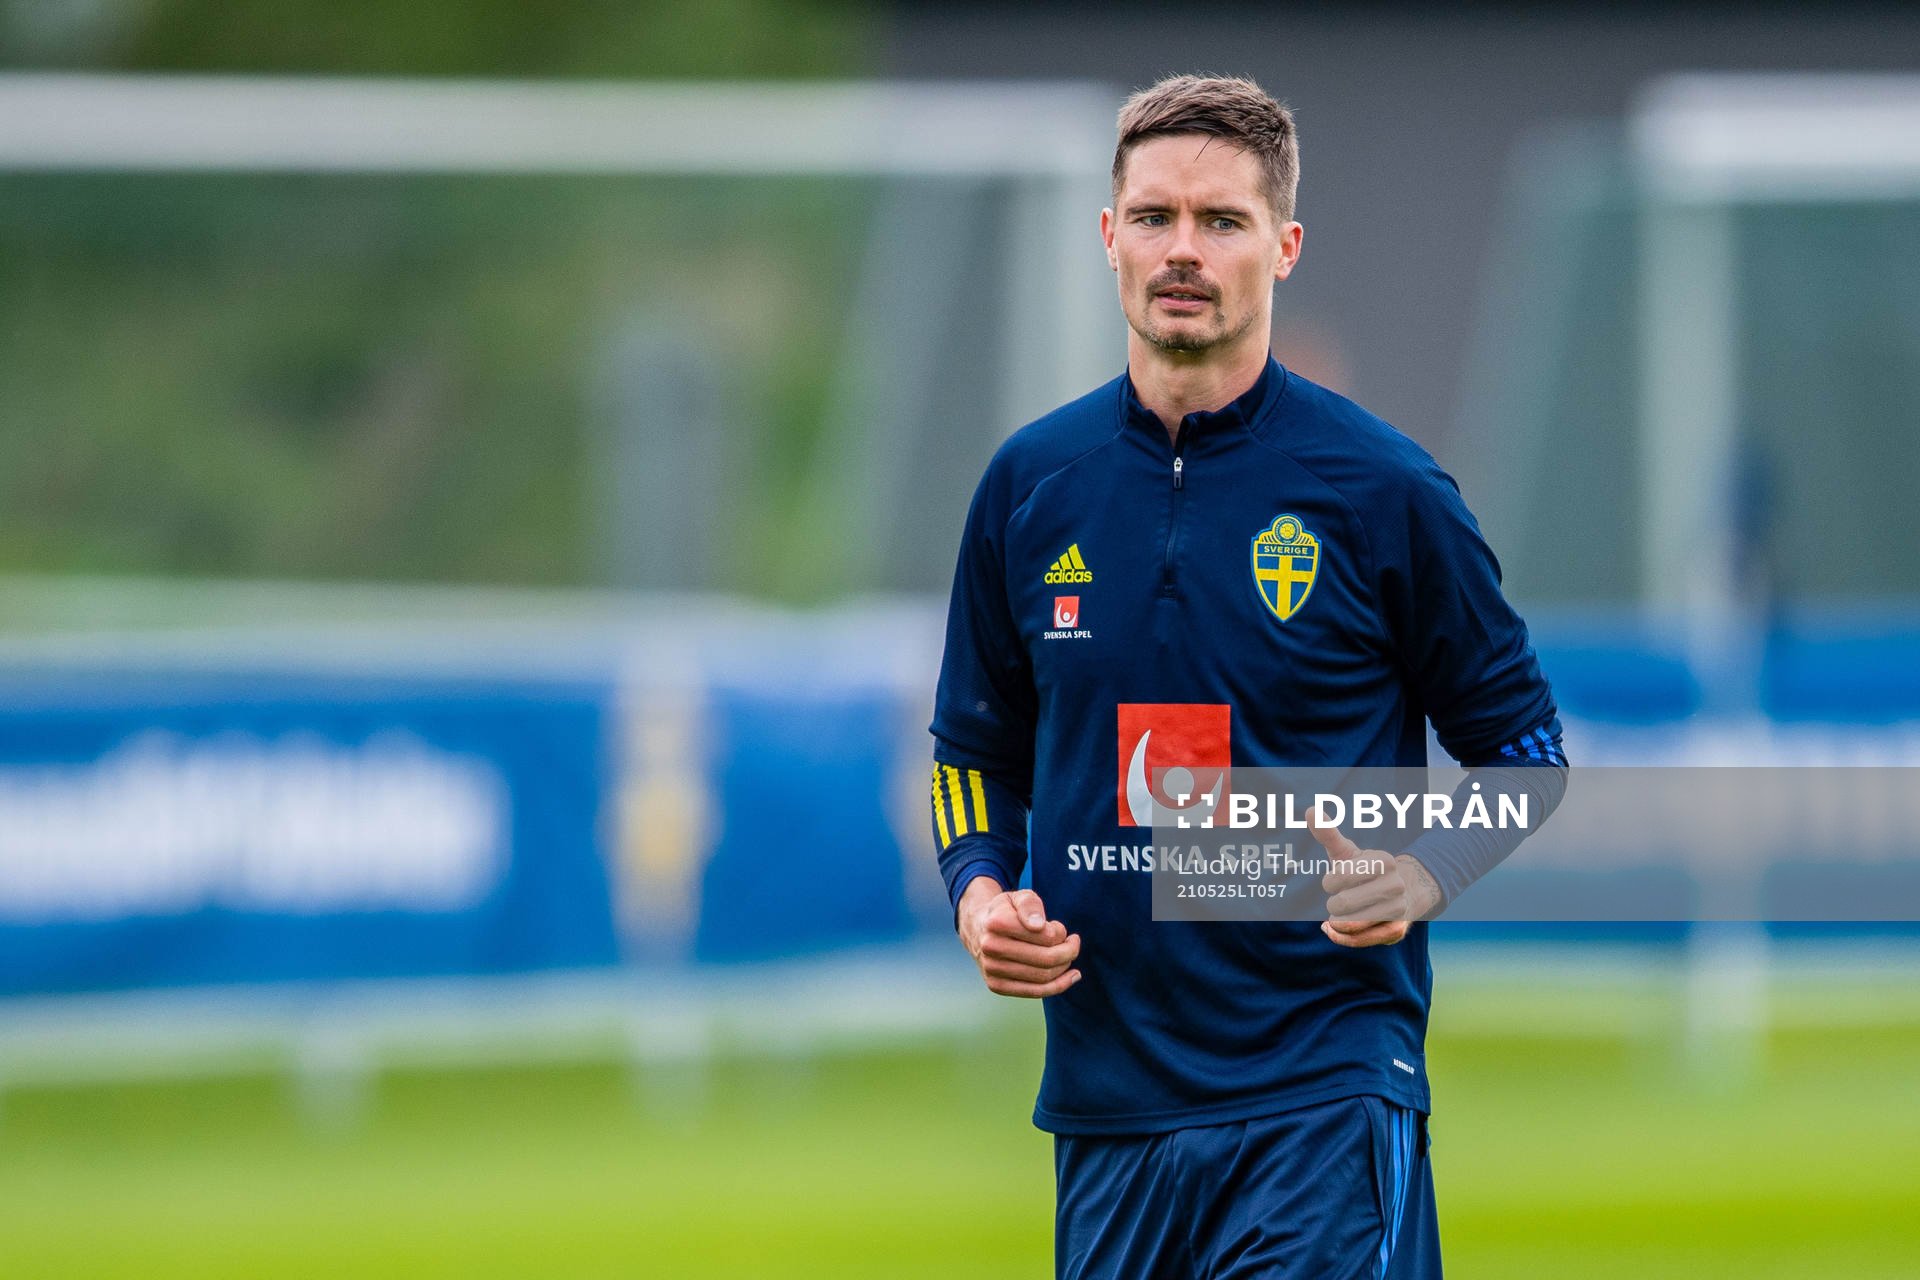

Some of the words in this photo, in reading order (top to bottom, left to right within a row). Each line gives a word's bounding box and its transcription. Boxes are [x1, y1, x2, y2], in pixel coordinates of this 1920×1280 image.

[1264, 545, 1309, 555] SVERIGE
[1044, 568, 1093, 584] adidas
[1044, 631, 1072, 640] SVENSKA
[1073, 630, 1092, 638] SPEL
[1068, 844, 1208, 872] SVENSKA
[1219, 843, 1301, 871] SPEL
